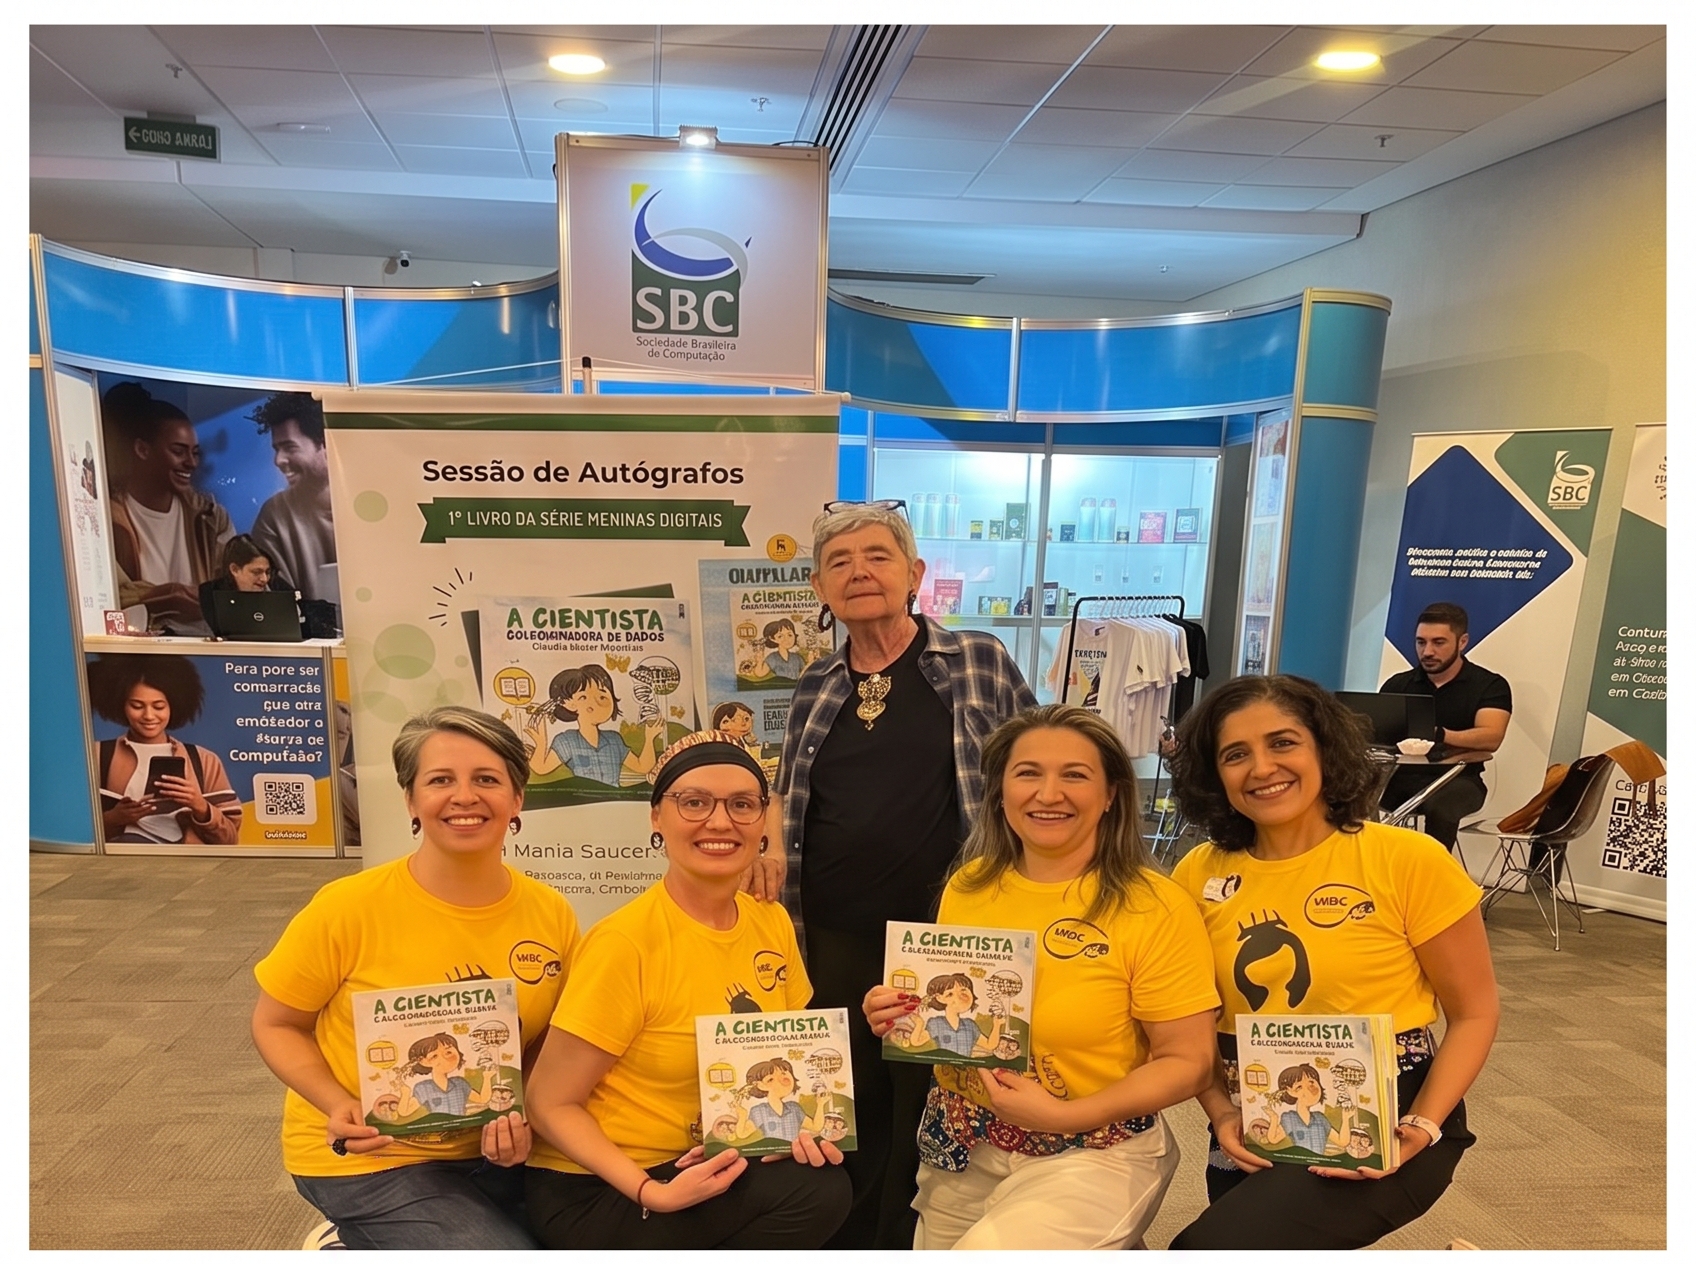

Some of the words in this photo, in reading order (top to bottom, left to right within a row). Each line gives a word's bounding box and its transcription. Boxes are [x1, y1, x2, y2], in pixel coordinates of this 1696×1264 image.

[636, 286, 735, 333] SBC
[636, 336, 688, 348] Sociedade
[691, 339, 737, 350] Brasileira
[648, 348, 660, 358] de
[663, 349, 726, 362] Computação
[422, 459, 525, 483] Sessão
[533, 461, 570, 483] de
[578, 461, 745, 488] Autógrafos
[1550, 485, 1588, 501] SBC
[467, 511, 511, 527] LIVRO
[516, 512, 536, 527] DA
[540, 508, 584, 527] SÉRIE
[588, 512, 656, 528] MENINAS
[660, 513, 723, 528] DIGITAIS
[506, 607, 523, 629] A
[532, 607, 664, 631] CIENTISTA
[608, 631, 622, 642] DE
[626, 631, 665, 642] DADOS
[225, 662, 257, 674] Para
[299, 666, 319, 676] ser
[515, 843, 573, 858] Mania
[902, 930, 914, 945] A
[919, 931, 1014, 953] CIENTISTA
[374, 999, 387, 1015] A
[393, 988, 496, 1012] CIENTISTA
[715, 1021, 727, 1036] A
[733, 1016, 829, 1035] CIENTISTA
[1251, 1022, 1261, 1038] A
[1265, 1022, 1353, 1040] CIENTISTA
